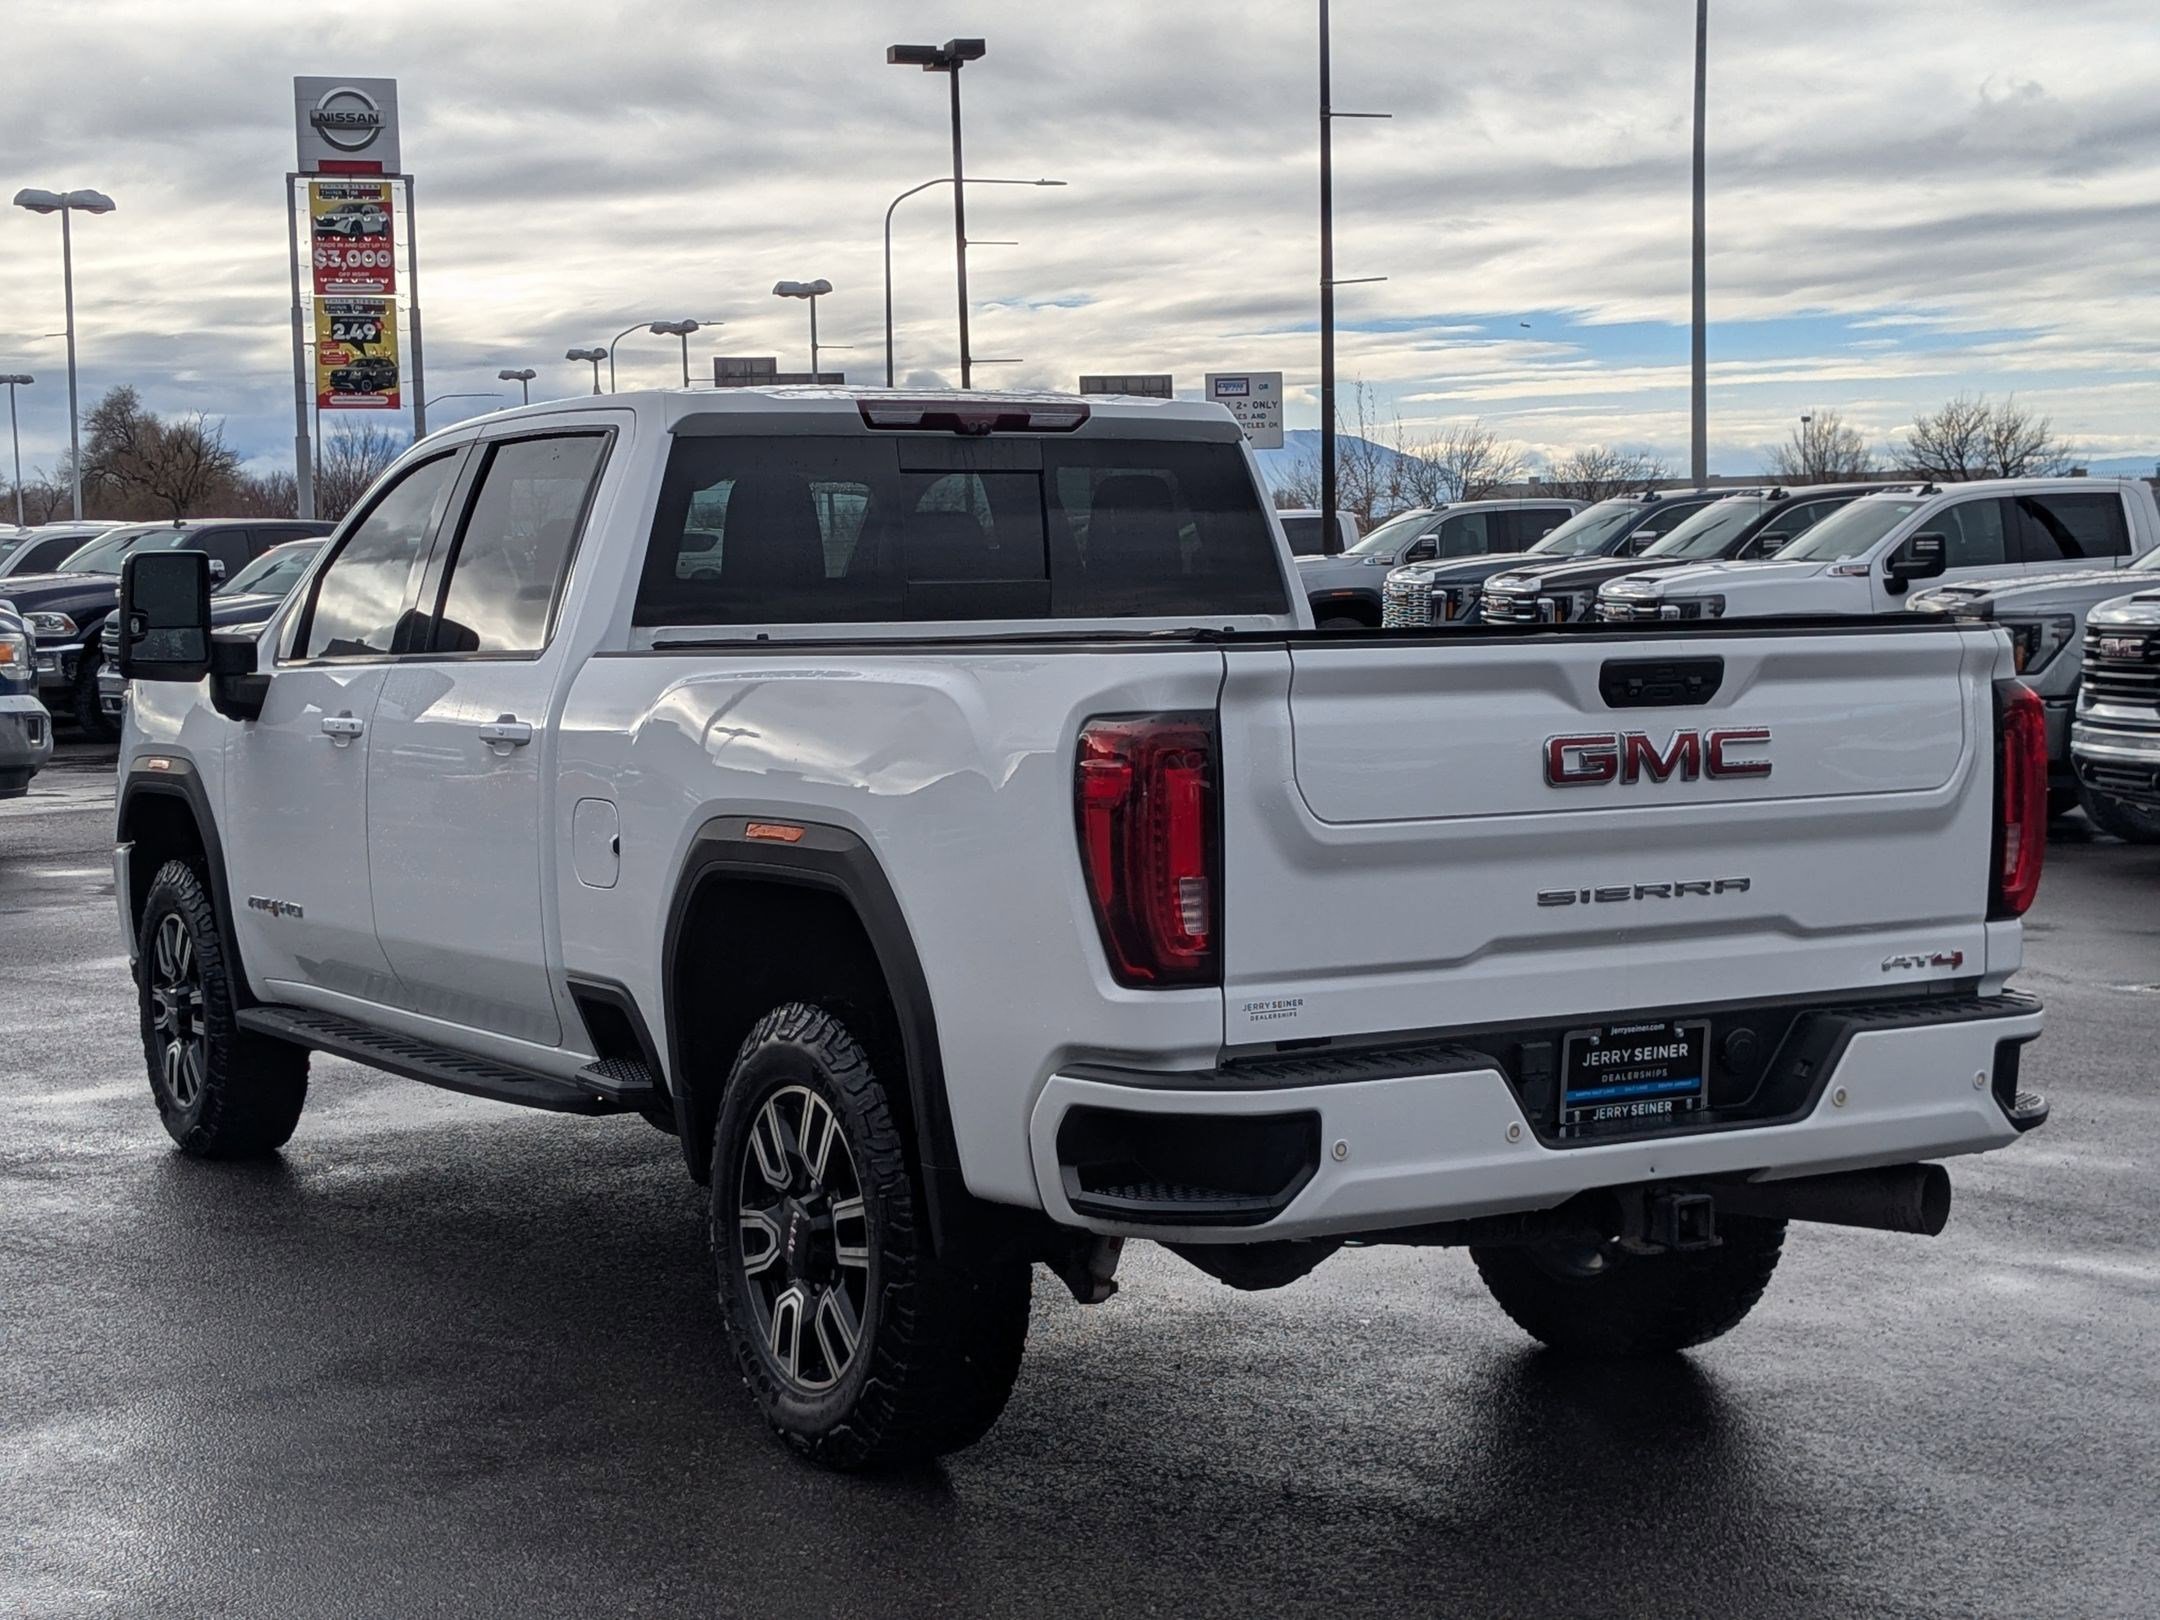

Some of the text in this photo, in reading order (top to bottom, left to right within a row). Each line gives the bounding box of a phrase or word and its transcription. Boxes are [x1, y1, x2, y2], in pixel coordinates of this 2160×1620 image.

[318, 112, 379, 124] NISSAN
[314, 248, 391, 271] $3,000
[333, 323, 376, 340] 2.49
[1252, 401, 1278, 409] ONLY
[1543, 726, 1772, 788] GMC
[1537, 876, 1750, 907] SIERRA
[1881, 949, 1963, 972] AT4
[1242, 998, 1303, 1012] JERRY SEINER
[1250, 1011, 1297, 1021] DEALERSHIPS
[1610, 1023, 1665, 1035] jerryseiner.com
[1582, 1043, 1688, 1067] JERRY SEINER
[1601, 1068, 1668, 1083] DEALERSHIPS
[1592, 1101, 1672, 1121] JERRY SEINER
